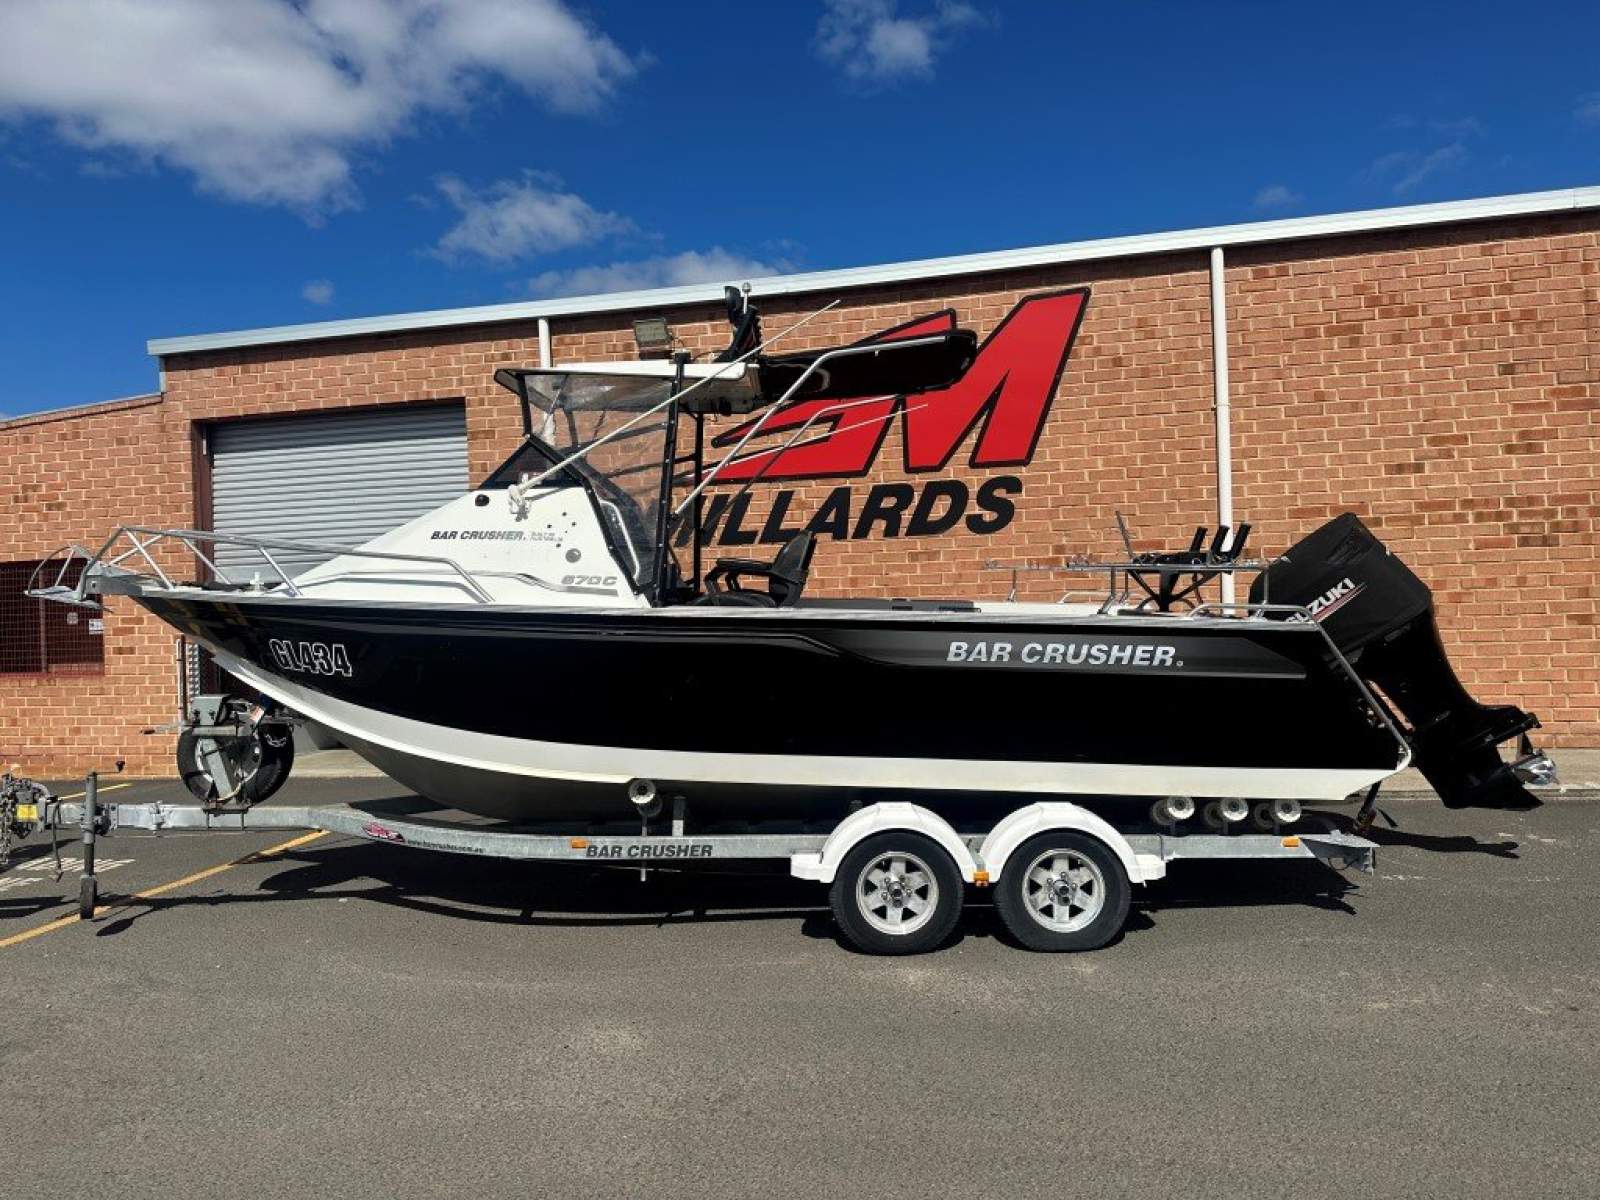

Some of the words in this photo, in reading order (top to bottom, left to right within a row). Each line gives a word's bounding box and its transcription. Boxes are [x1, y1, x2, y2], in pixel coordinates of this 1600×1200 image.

[430, 530, 458, 541] BAR
[946, 641, 1012, 662] BAR
[586, 844, 623, 857] BAR
[627, 844, 713, 857] CRUSHER
